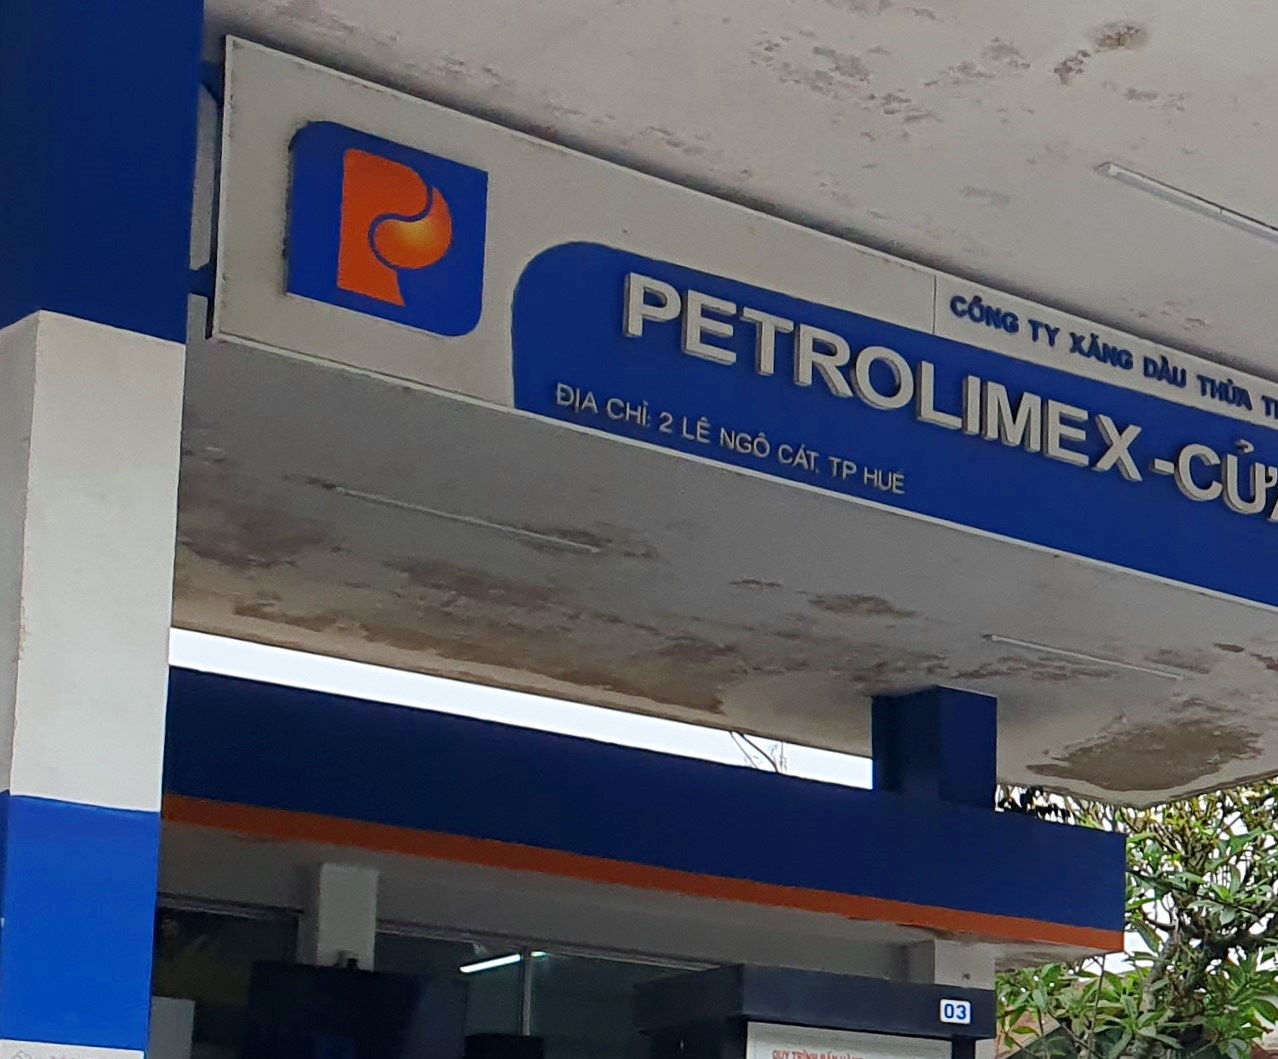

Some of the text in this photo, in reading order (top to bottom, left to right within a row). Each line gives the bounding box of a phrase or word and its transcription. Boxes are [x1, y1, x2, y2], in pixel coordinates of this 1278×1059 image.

[949, 294, 1019, 334] CÔNG
[1028, 319, 1060, 348] TY
[1070, 331, 1133, 371] XĂNG
[1143, 353, 1188, 389] DẦU
[1197, 373, 1253, 412] THỪA
[556, 382, 598, 415] ĐỊA
[659, 412, 674, 434] 2
[682, 417, 711, 444] LÊ
[719, 427, 771, 459] NGÔ
[828, 456, 857, 480] TP
[943, 1003, 967, 1020] 03
